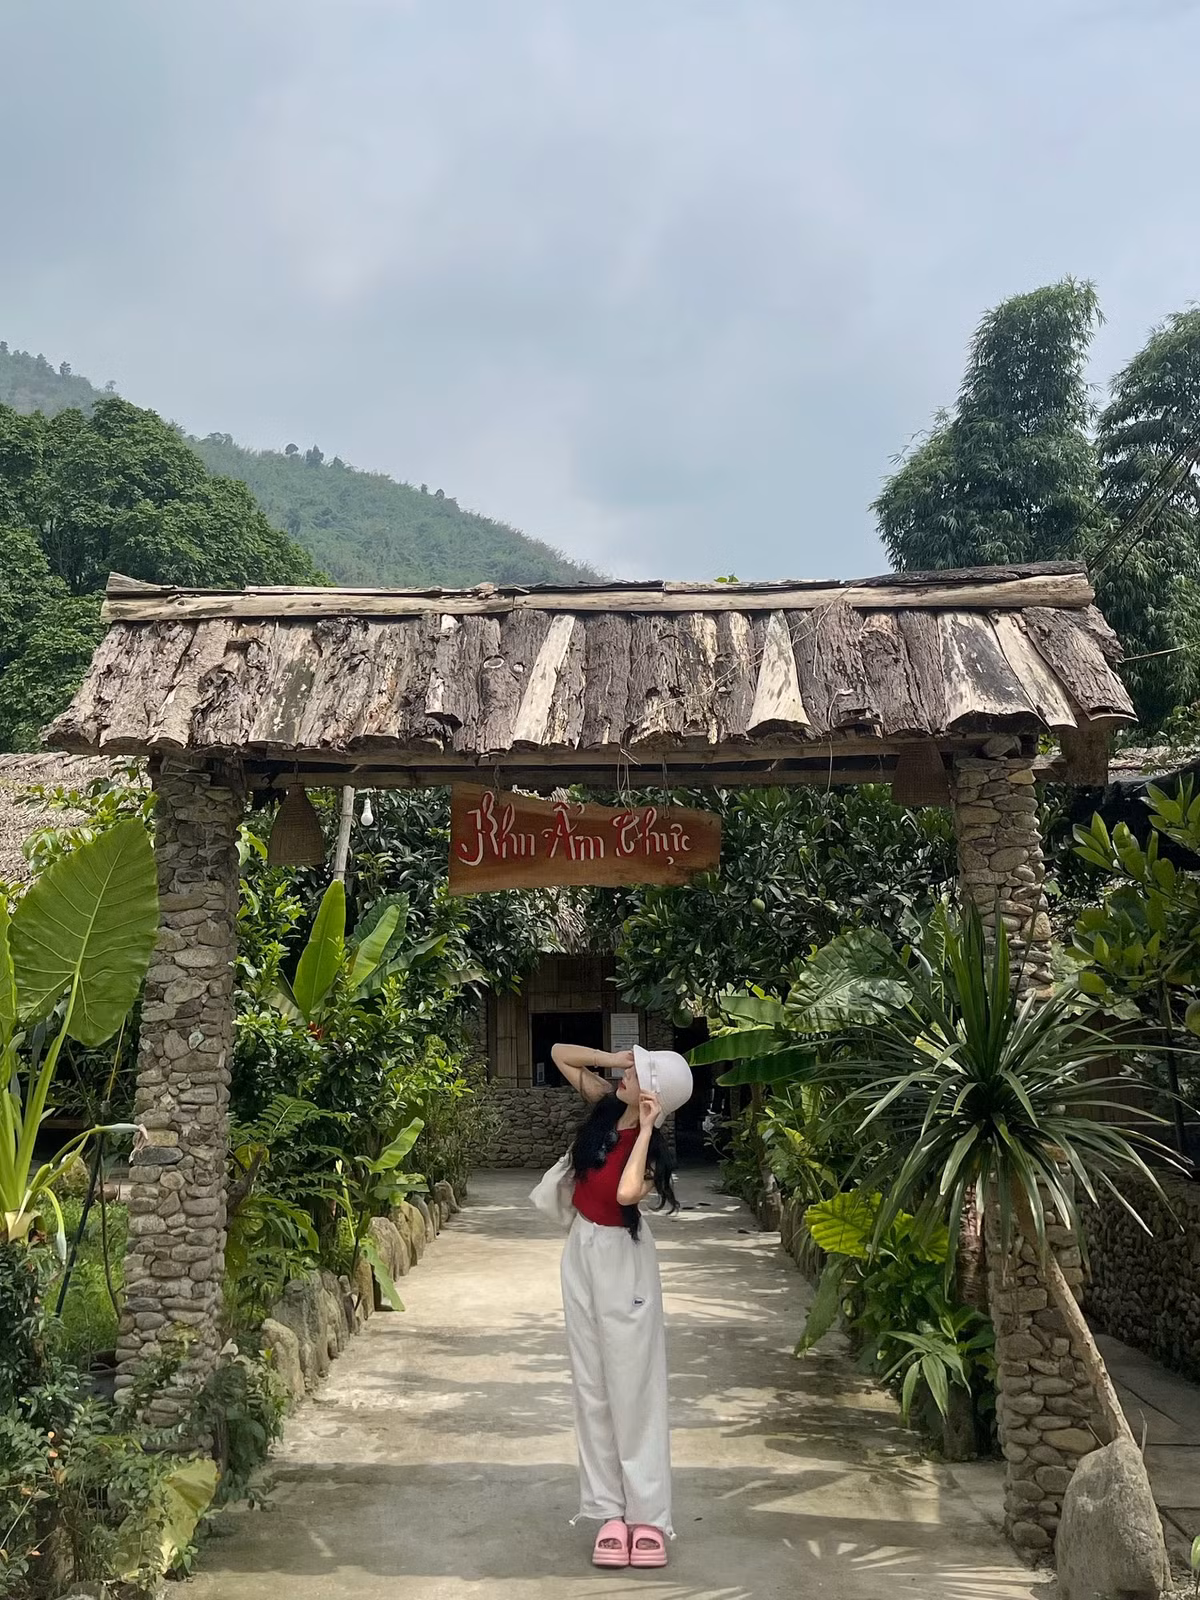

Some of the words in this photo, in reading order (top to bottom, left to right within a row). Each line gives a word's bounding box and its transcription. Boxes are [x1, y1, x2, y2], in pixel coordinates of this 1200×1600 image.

[457, 790, 536, 867] Khu
[541, 800, 605, 862] Ẩm
[611, 806, 692, 865] Thực
